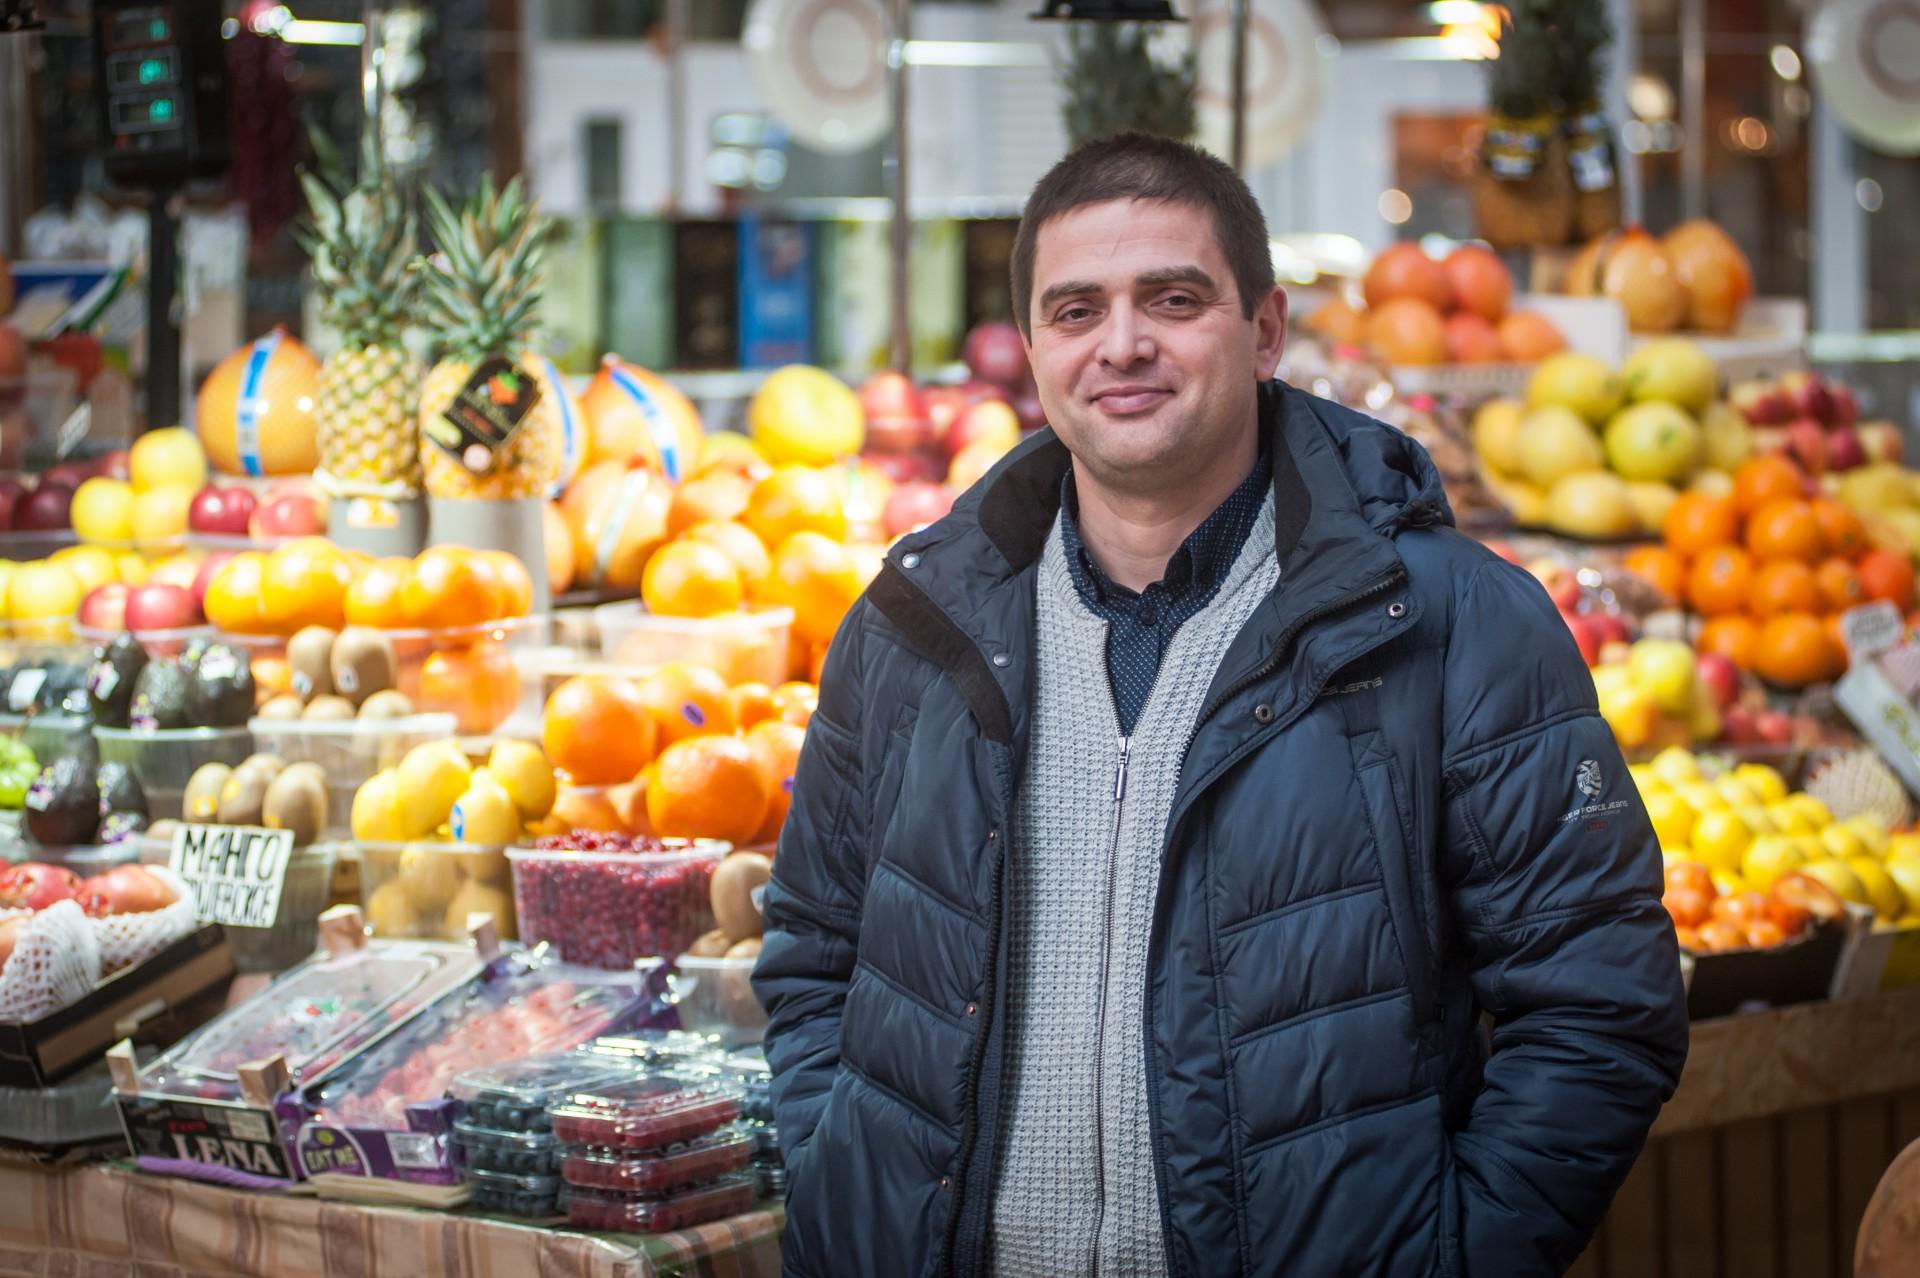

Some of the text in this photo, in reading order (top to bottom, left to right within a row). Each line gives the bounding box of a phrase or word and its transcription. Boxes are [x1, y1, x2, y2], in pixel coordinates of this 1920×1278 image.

[182, 830, 280, 880] МАНГО
[171, 1133, 281, 1175] LENA
[304, 1145, 356, 1172] EAT ME
